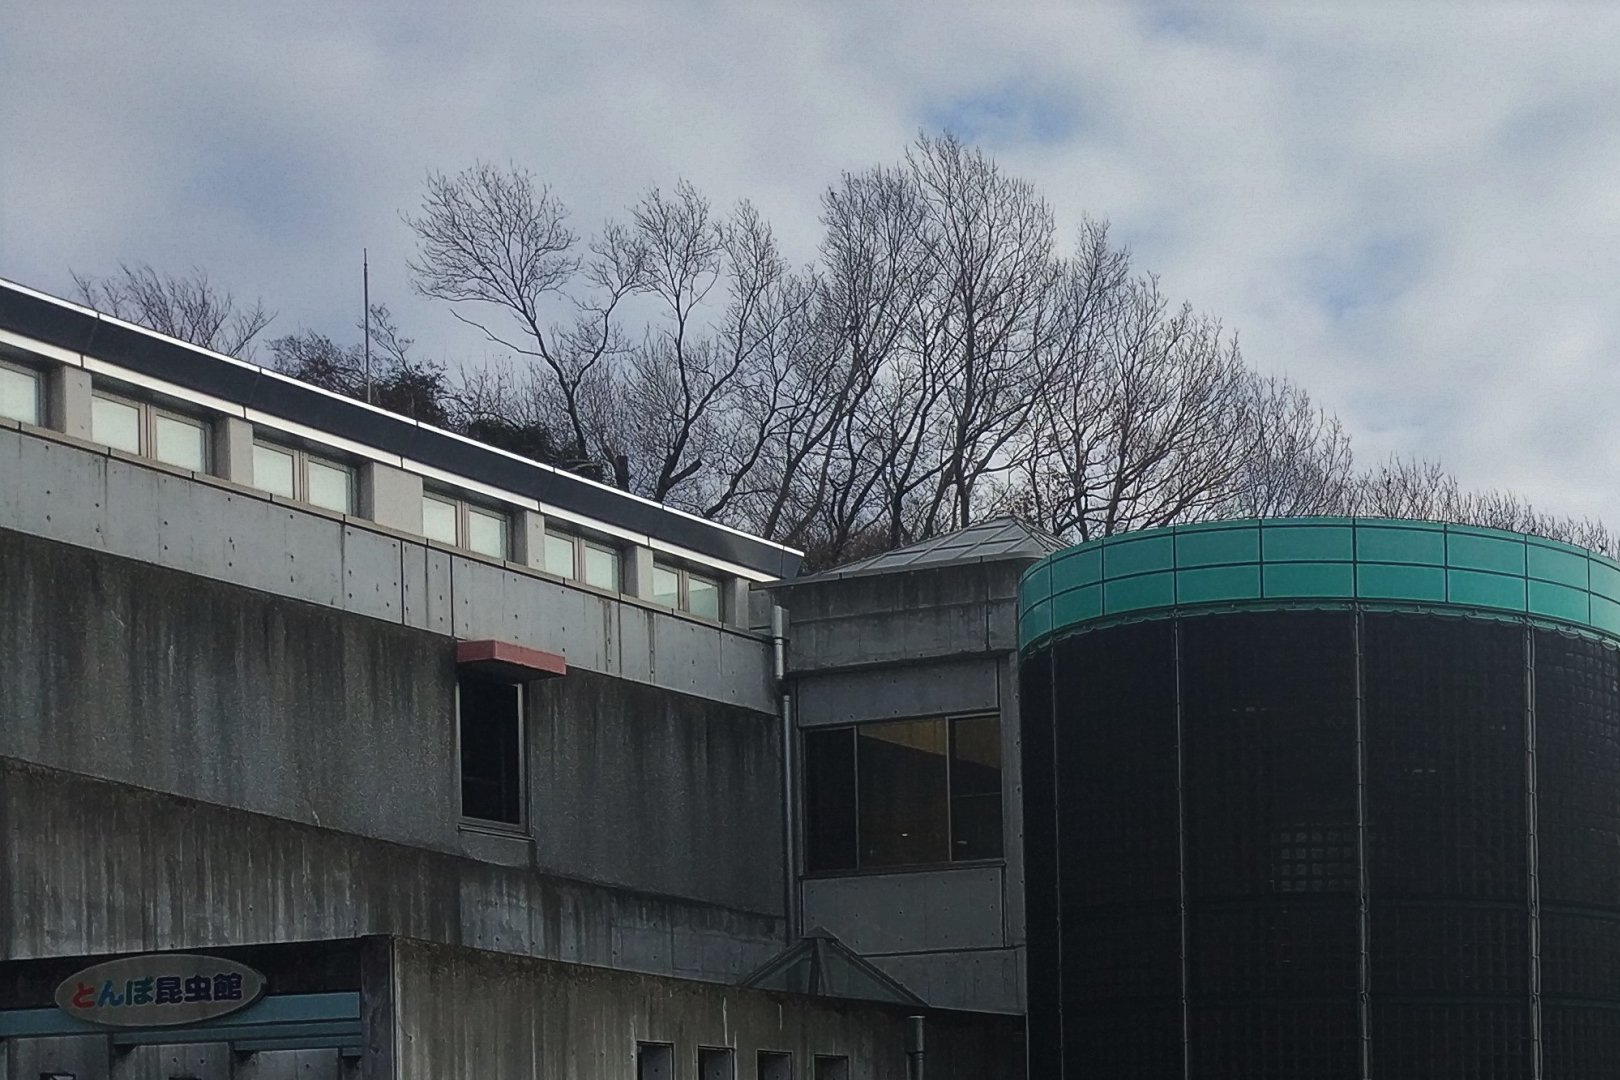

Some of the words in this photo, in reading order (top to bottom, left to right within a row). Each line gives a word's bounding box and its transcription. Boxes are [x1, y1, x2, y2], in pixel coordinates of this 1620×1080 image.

[73, 973, 242, 1008] とんぼ昆虫館
